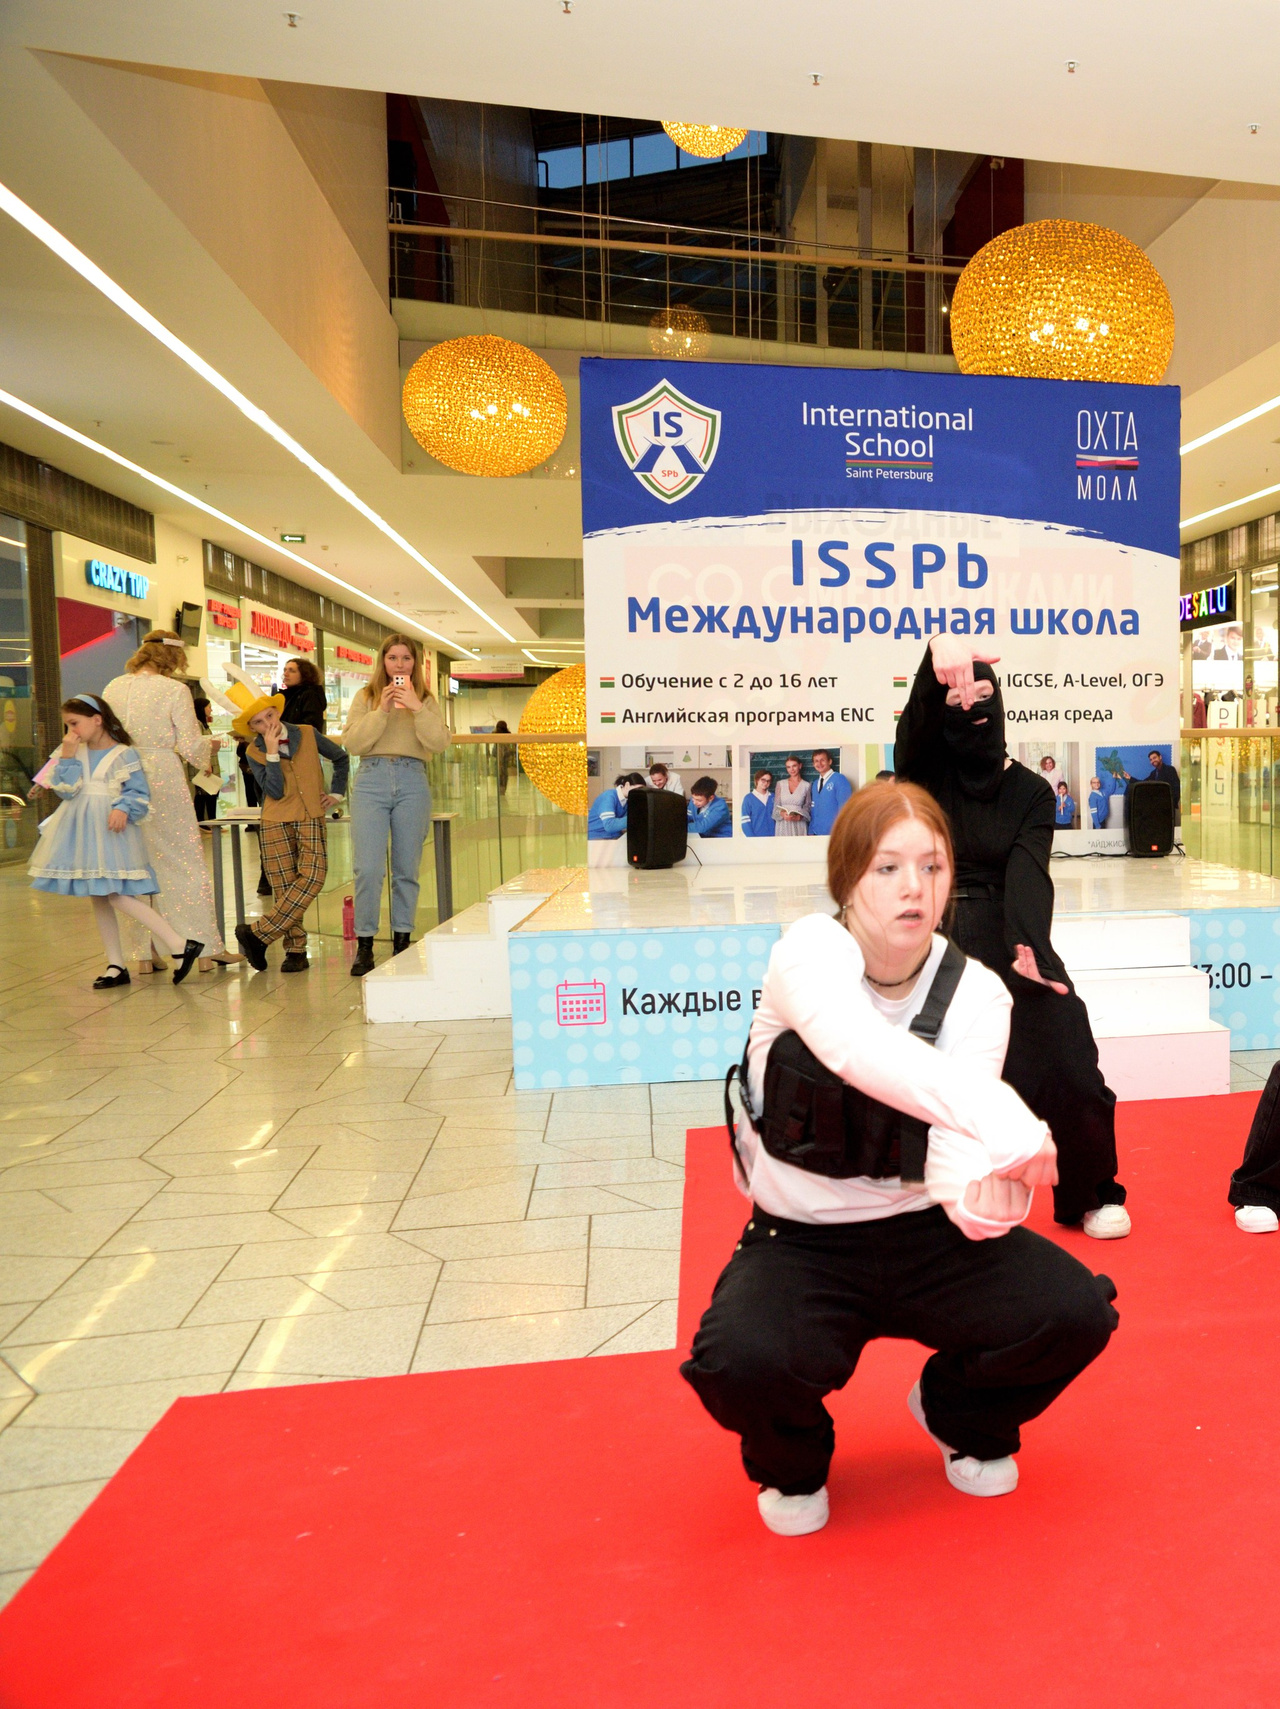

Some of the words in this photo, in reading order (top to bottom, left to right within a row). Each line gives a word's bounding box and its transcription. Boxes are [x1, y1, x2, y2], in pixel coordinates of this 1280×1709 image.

[652, 410, 684, 438] IS
[802, 402, 974, 432] International
[1077, 409, 1139, 451] ОХТА
[845, 431, 934, 458] School
[661, 468, 679, 479] SPb
[845, 467, 873, 479] Saint
[875, 468, 934, 483] Petersburg
[791, 539, 989, 590] ISSPb
[91, 558, 128, 594] CRAZY
[128, 571, 150, 599] ТИР
[251, 610, 294, 648] ЛЕОНАРДО
[627, 596, 996, 643] Международная
[1010, 607, 1140, 636] школа
[621, 673, 713, 692] Обучение
[718, 677, 728, 688] с
[733, 674, 745, 688] 2
[750, 677, 773, 691] до
[779, 673, 802, 688] 16
[808, 677, 838, 688] лет
[1007, 673, 1058, 690] IGCSE,
[1063, 673, 1127, 691] A-Level,
[1132, 674, 1164, 687] ОГЭ
[621, 708, 729, 724] Английская
[735, 709, 835, 726] программа
[841, 707, 875, 723] ENC
[1064, 710, 1113, 724] среда
[1193, 962, 1252, 989] 3:00
[621, 987, 742, 1018] Каждые
